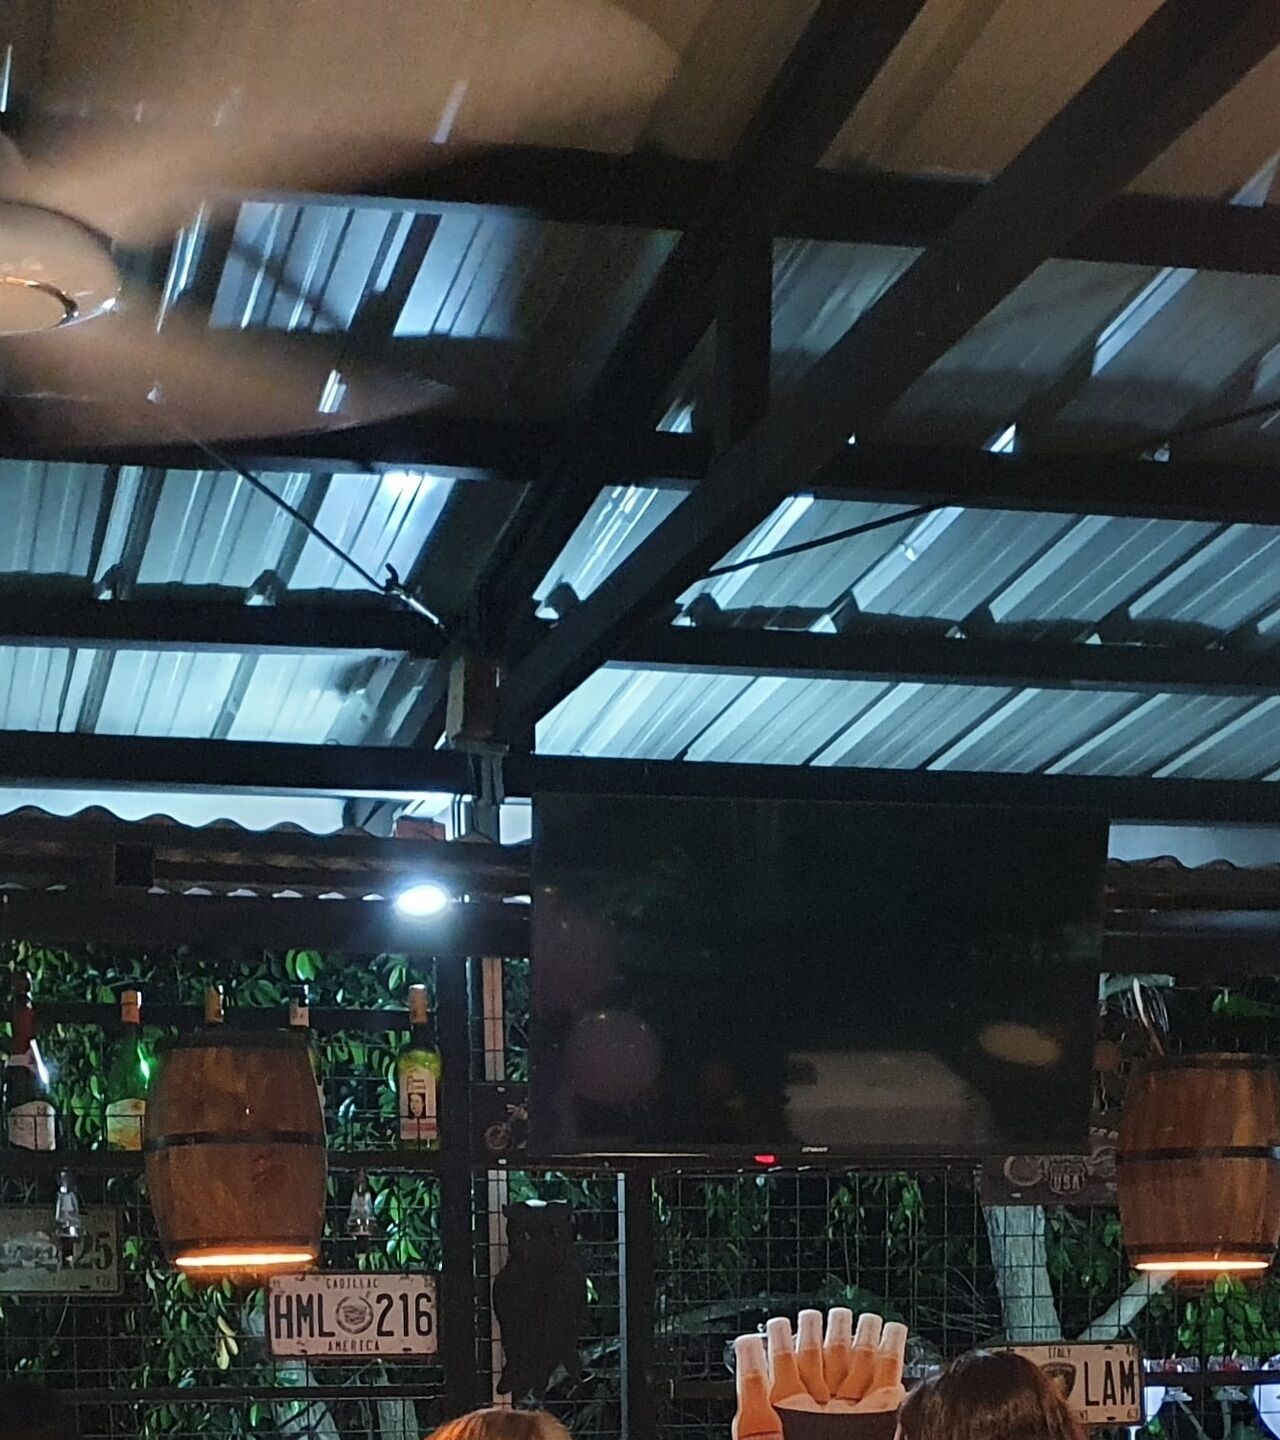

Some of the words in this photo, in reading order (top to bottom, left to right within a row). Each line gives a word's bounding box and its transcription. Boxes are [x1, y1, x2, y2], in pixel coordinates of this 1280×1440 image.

[1053, 1174, 1080, 1190] USA
[326, 1277, 379, 1290] CADILLAC
[274, 1293, 336, 1339] HML
[376, 1292, 433, 1337] 216
[327, 1340, 380, 1352] AMERICA
[1048, 1347, 1072, 1359] ITALY
[1083, 1360, 1136, 1407] LAM
